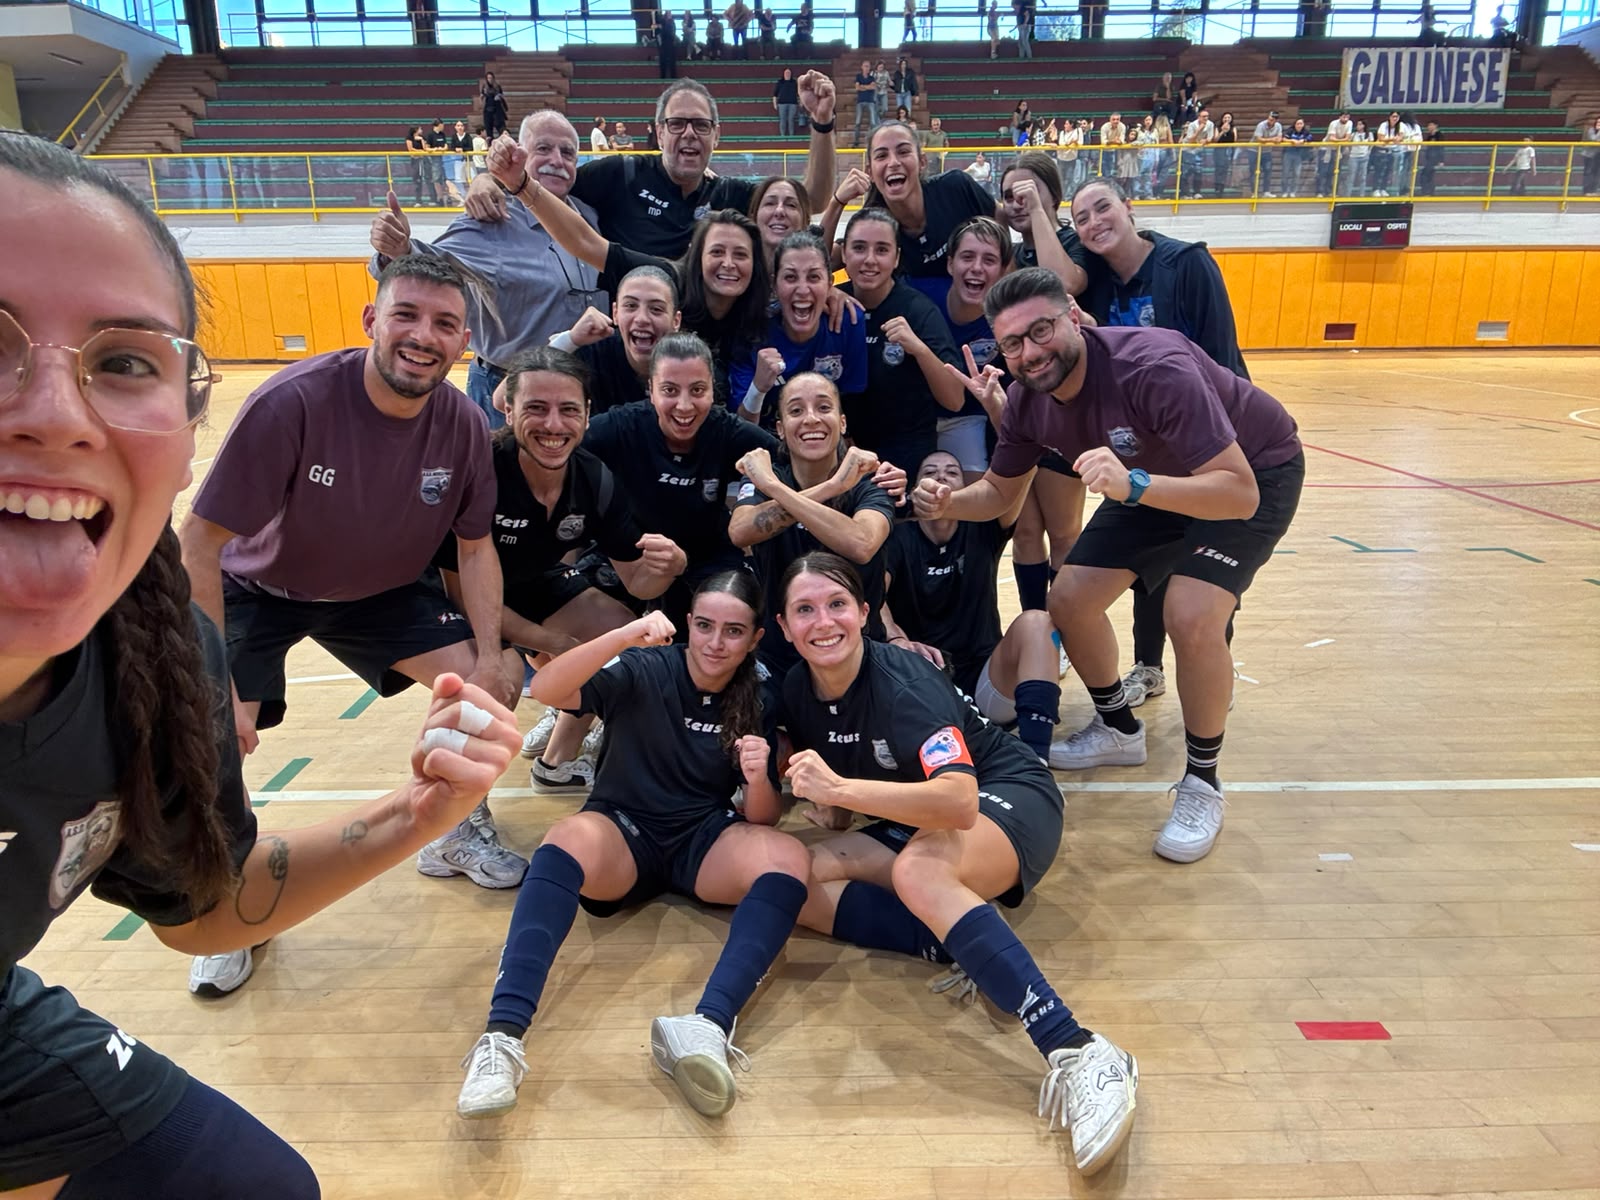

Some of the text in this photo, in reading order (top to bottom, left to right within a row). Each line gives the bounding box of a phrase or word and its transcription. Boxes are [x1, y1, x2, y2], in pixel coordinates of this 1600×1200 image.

[1350, 50, 1503, 105] GALLINESE
[638, 188, 669, 208] Zeus
[1339, 223, 1363, 231] LOCALI
[1386, 222, 1408, 230] OSPITI
[308, 464, 336, 487] GG
[658, 472, 697, 486] Zeus
[500, 534, 518, 545] FM
[1203, 548, 1239, 567] Zeus
[684, 717, 724, 734] Zeus
[828, 731, 860, 743] Zeus
[978, 791, 1014, 811] eus
